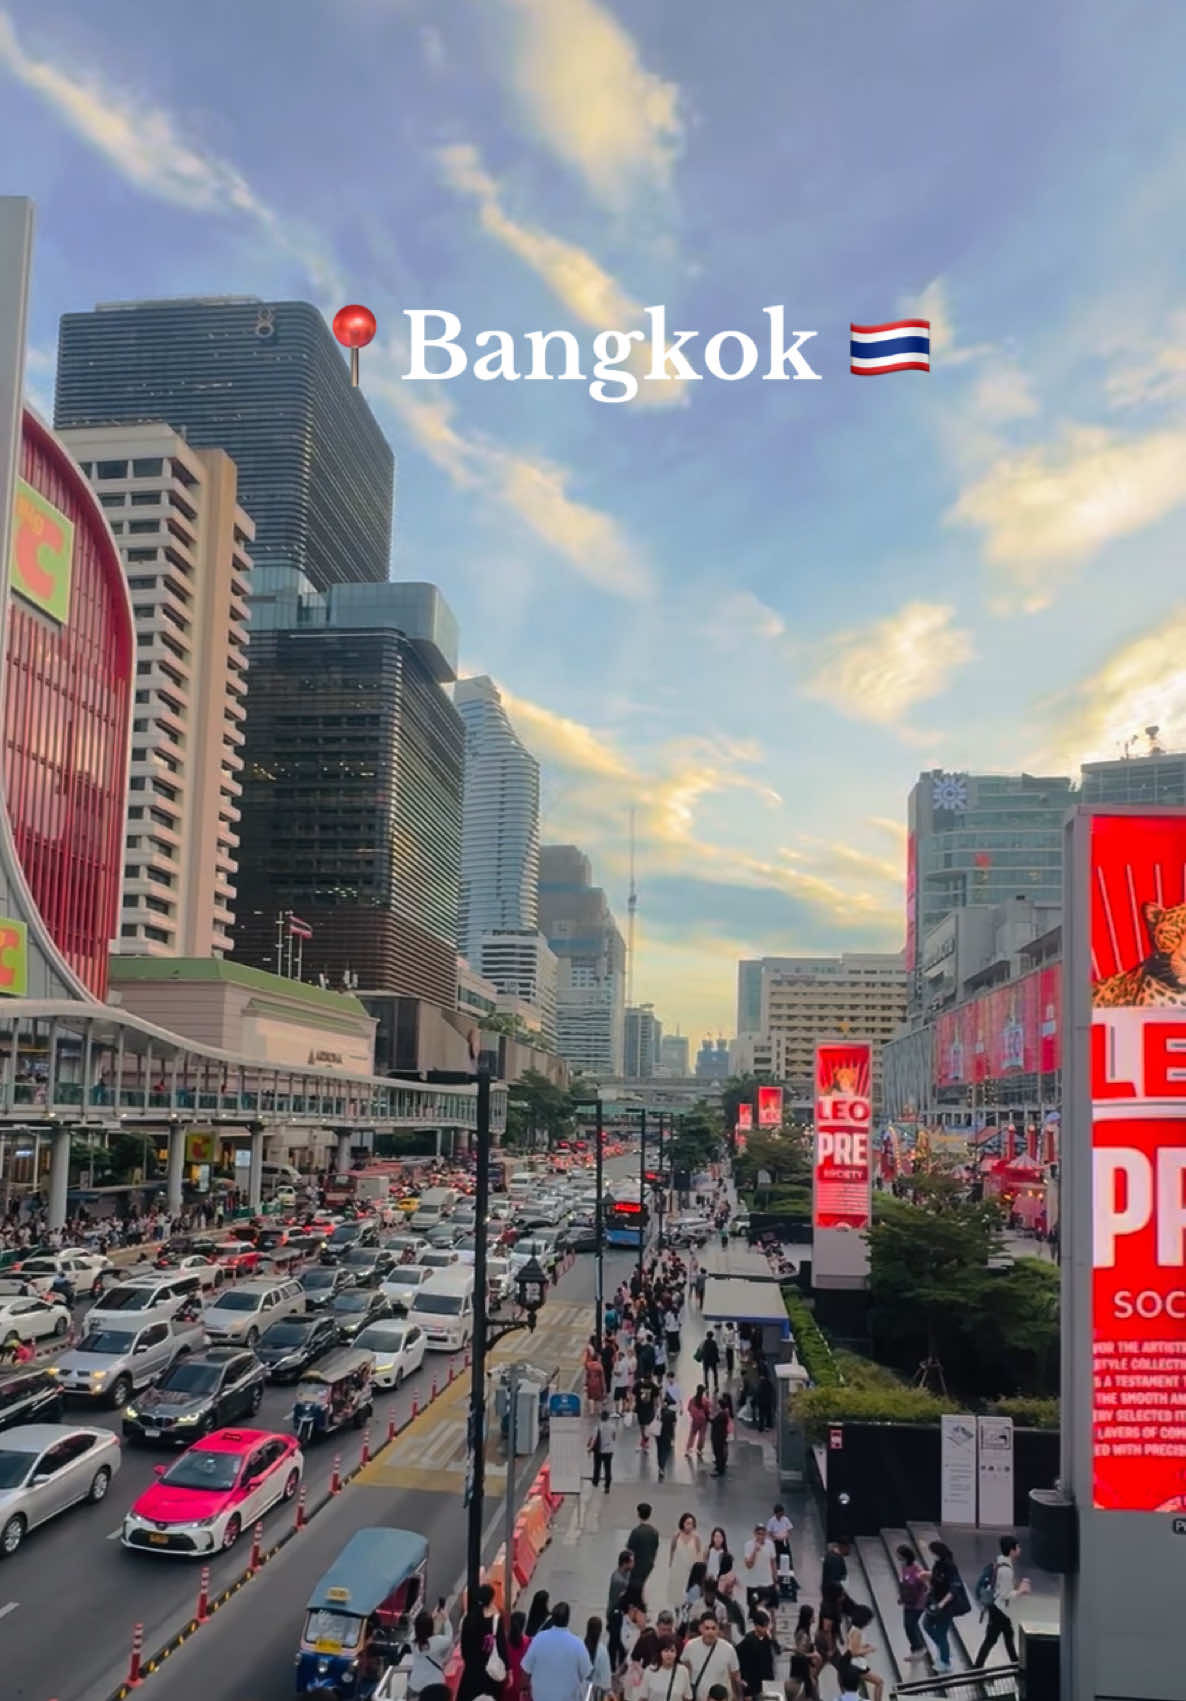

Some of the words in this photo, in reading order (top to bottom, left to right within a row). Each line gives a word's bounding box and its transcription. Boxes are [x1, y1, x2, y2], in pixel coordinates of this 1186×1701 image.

[818, 1099, 870, 1122] LEO
[818, 1132, 868, 1166] PRE
[1113, 1290, 1186, 1318] SOC
[1115, 1375, 1180, 1388] TESTAMENT
[1120, 1392, 1168, 1405] SMOOTH
[1115, 1409, 1173, 1422] SELECTED
[1142, 1426, 1159, 1439] OF
[1112, 1443, 1142, 1456] WITH
